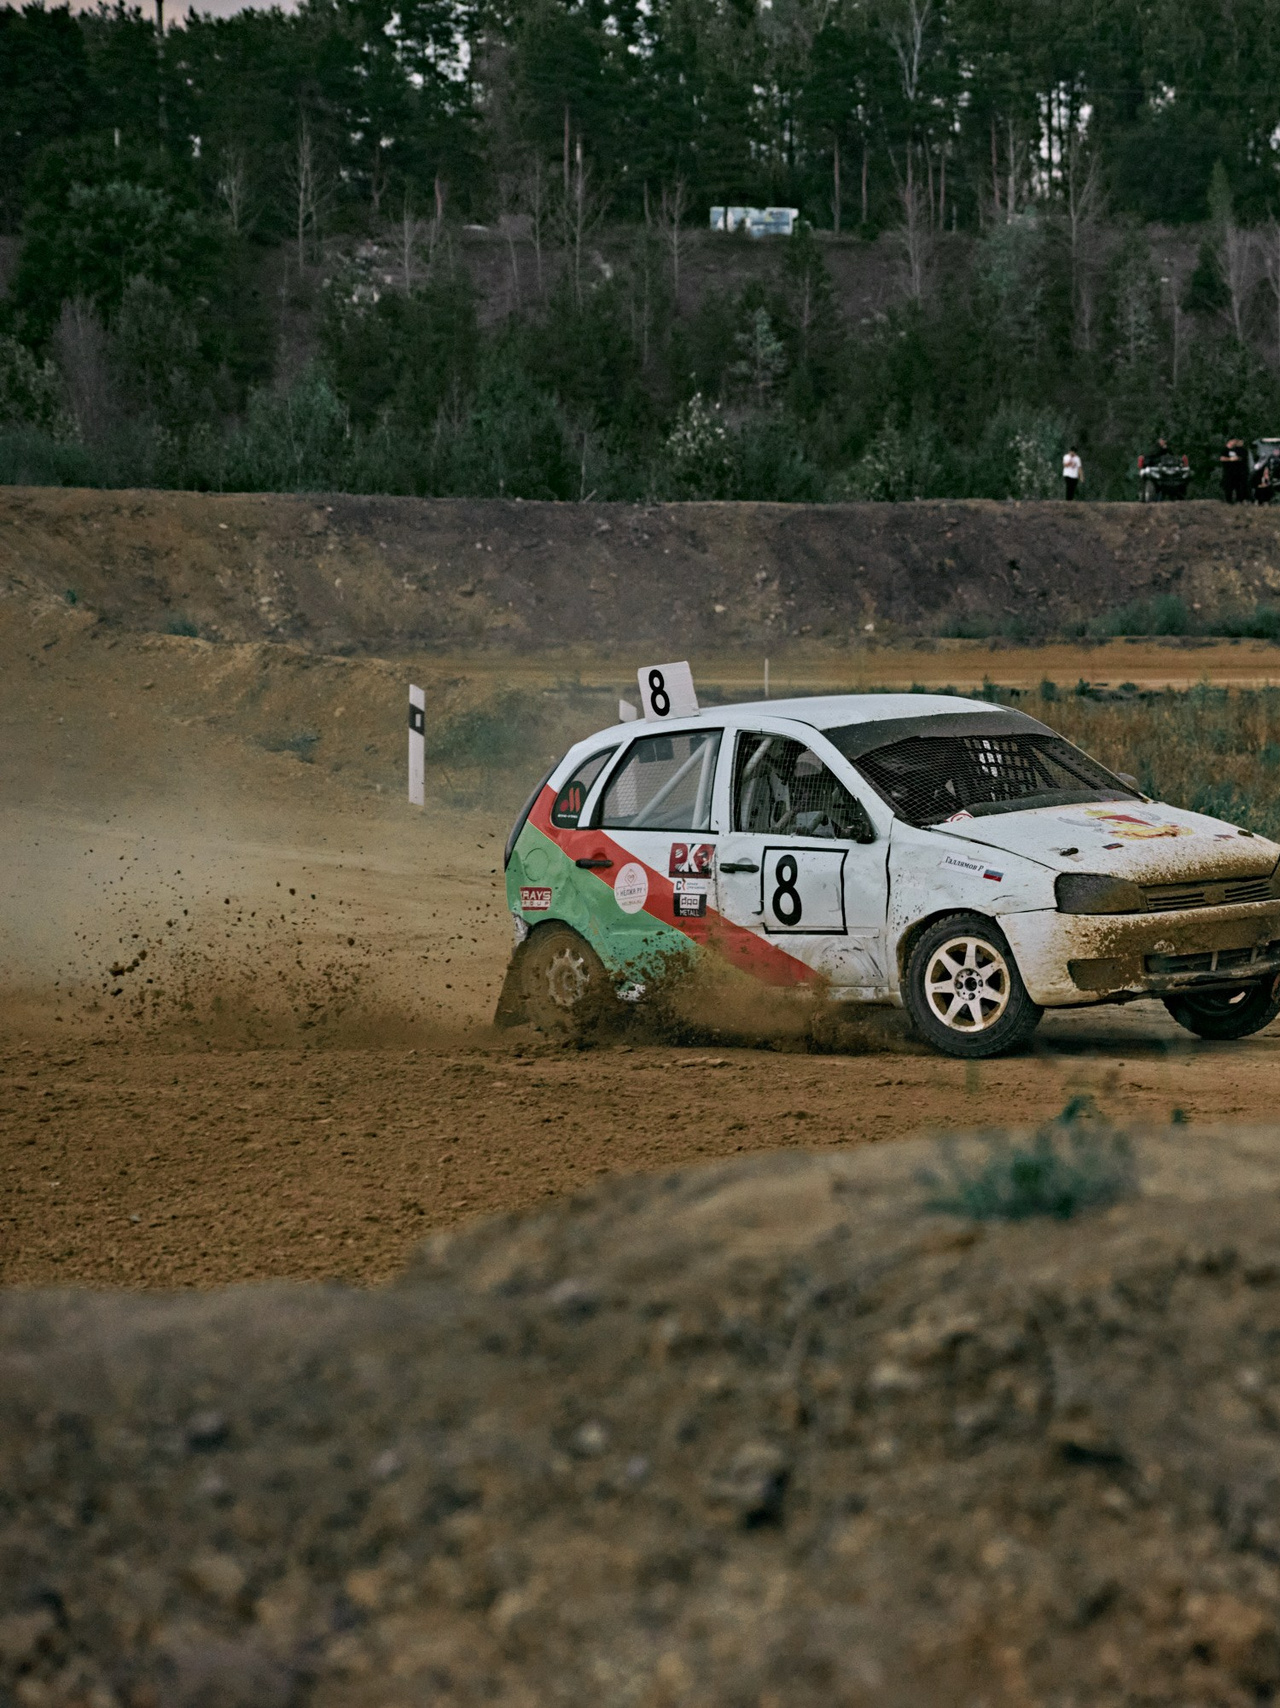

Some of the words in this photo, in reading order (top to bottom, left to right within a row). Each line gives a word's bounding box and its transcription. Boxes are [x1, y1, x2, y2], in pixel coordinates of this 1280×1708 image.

[648, 669, 671, 717] 8
[680, 909, 700, 917] METALL
[772, 854, 802, 926] 8
